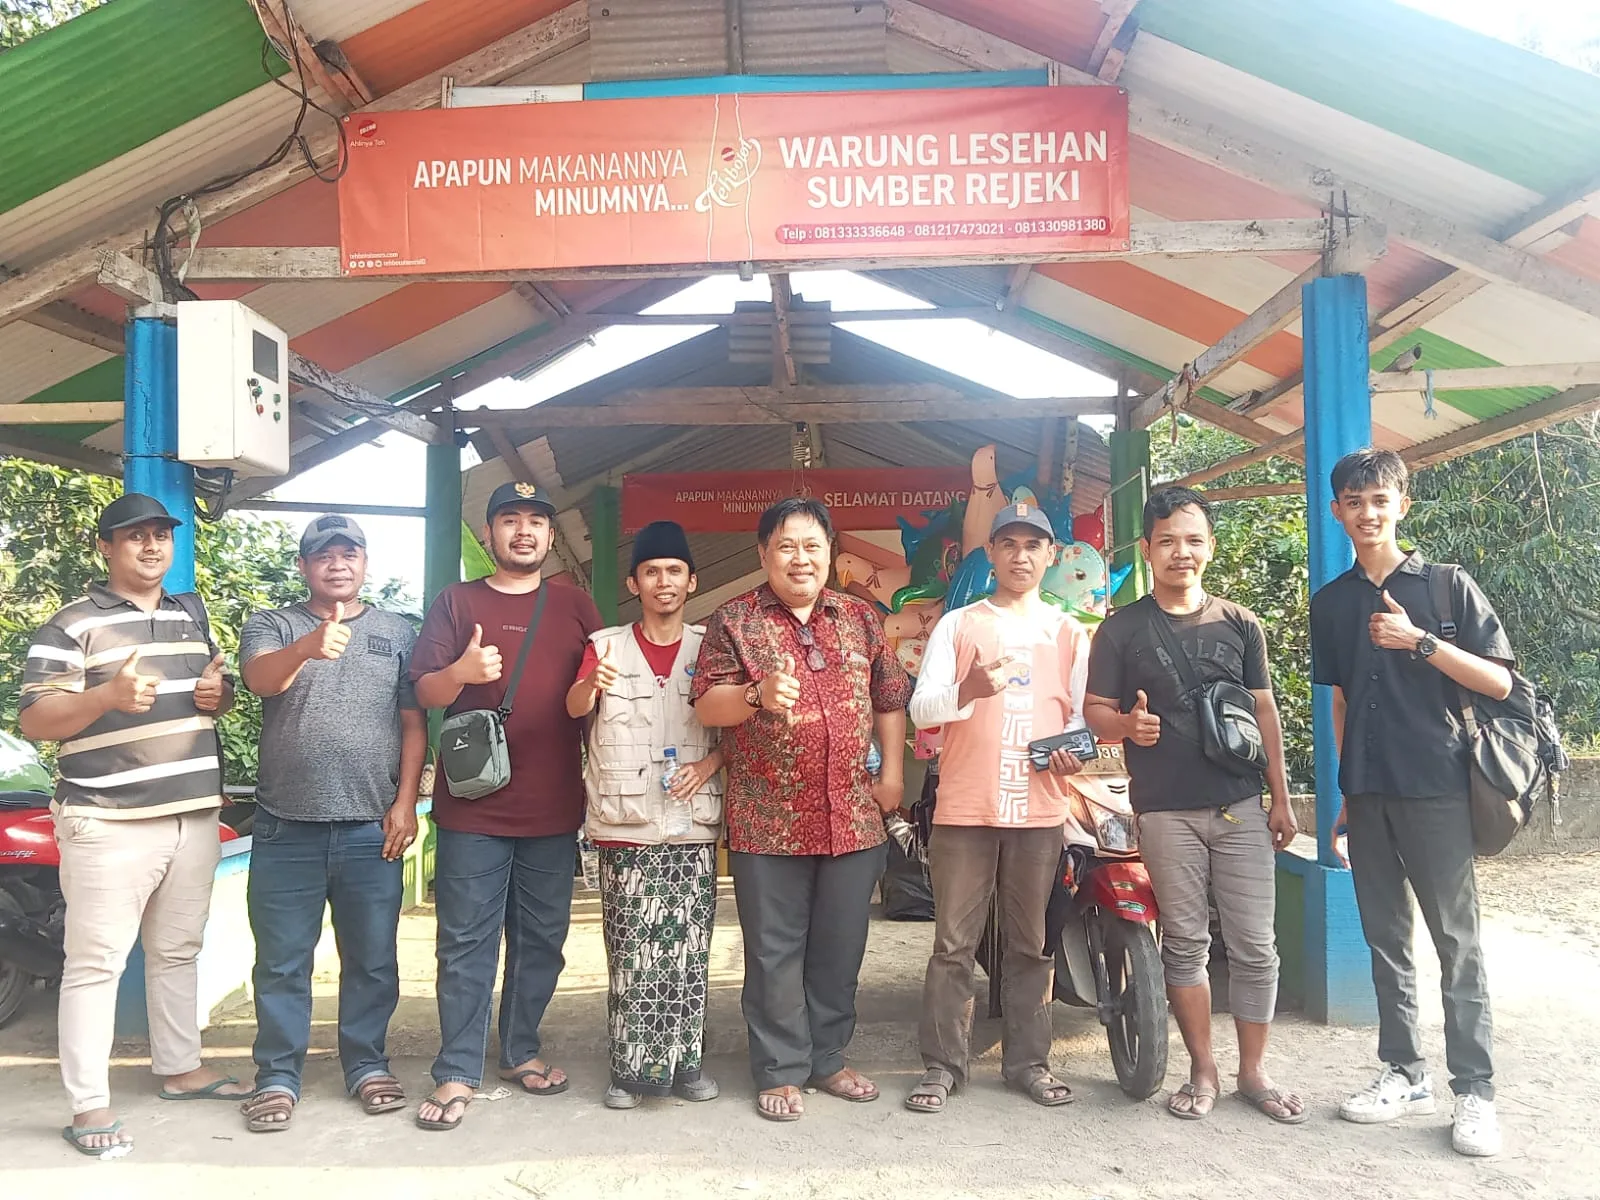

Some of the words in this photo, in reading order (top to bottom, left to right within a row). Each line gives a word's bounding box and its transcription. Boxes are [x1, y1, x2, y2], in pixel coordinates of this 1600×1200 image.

[778, 134, 939, 169] WARUNG
[949, 130, 1107, 166] LESEHAN
[413, 158, 511, 189] APAPUN
[519, 149, 688, 184] MAKANANNYA
[535, 183, 689, 217] MINUMNYA...
[807, 173, 956, 209] SUMBER
[966, 170, 1080, 209] REJEKI
[782, 227, 806, 241] Telp
[814, 225, 905, 239] 081333336648
[914, 223, 1005, 236] 081217473021
[1014, 218, 1106, 234] 081330981380
[675, 490, 715, 503] APAPUN
[717, 488, 783, 501] MAKANANNYA
[823, 491, 898, 507] SELAMAT
[902, 490, 966, 506] DATANG
